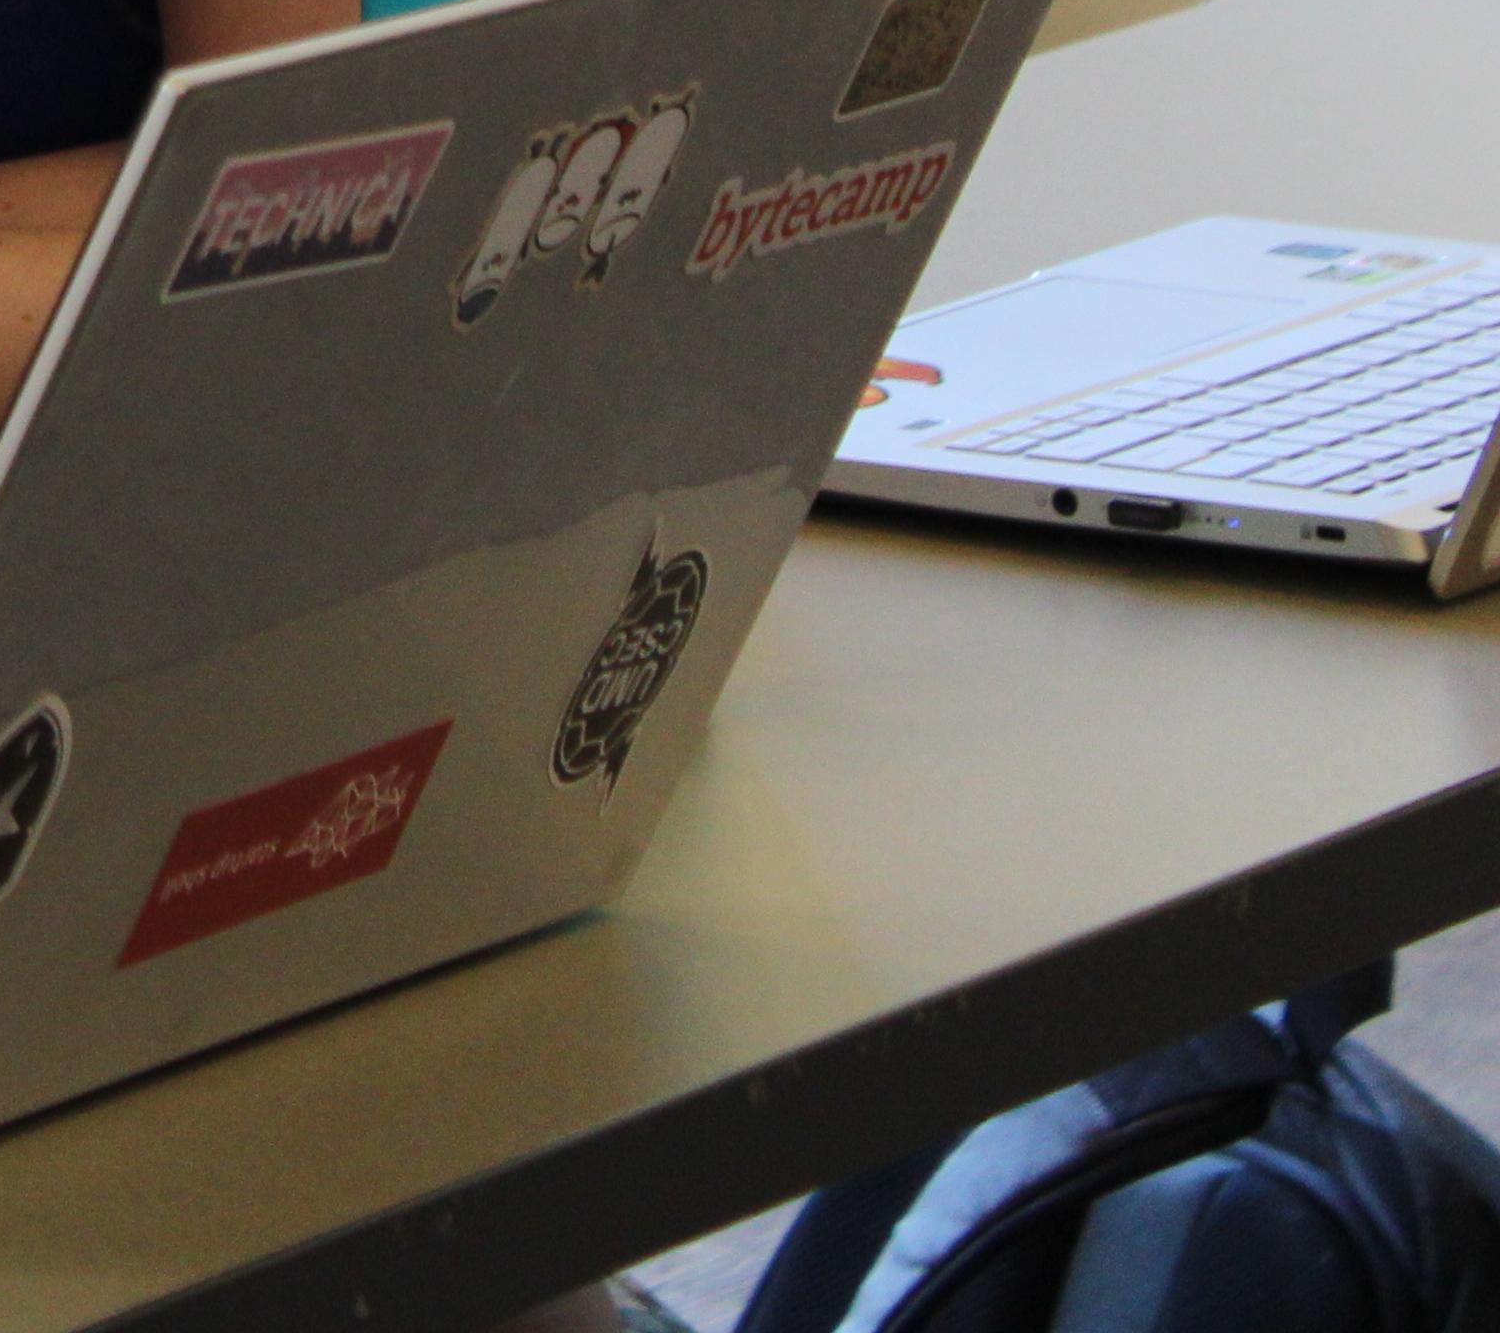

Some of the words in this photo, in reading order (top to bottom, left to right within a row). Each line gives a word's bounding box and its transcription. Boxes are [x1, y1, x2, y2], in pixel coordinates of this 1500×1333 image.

[695, 152, 948, 269] bytecamp
[601, 619, 684, 667] CSEC
[581, 660, 659, 715] UMD
